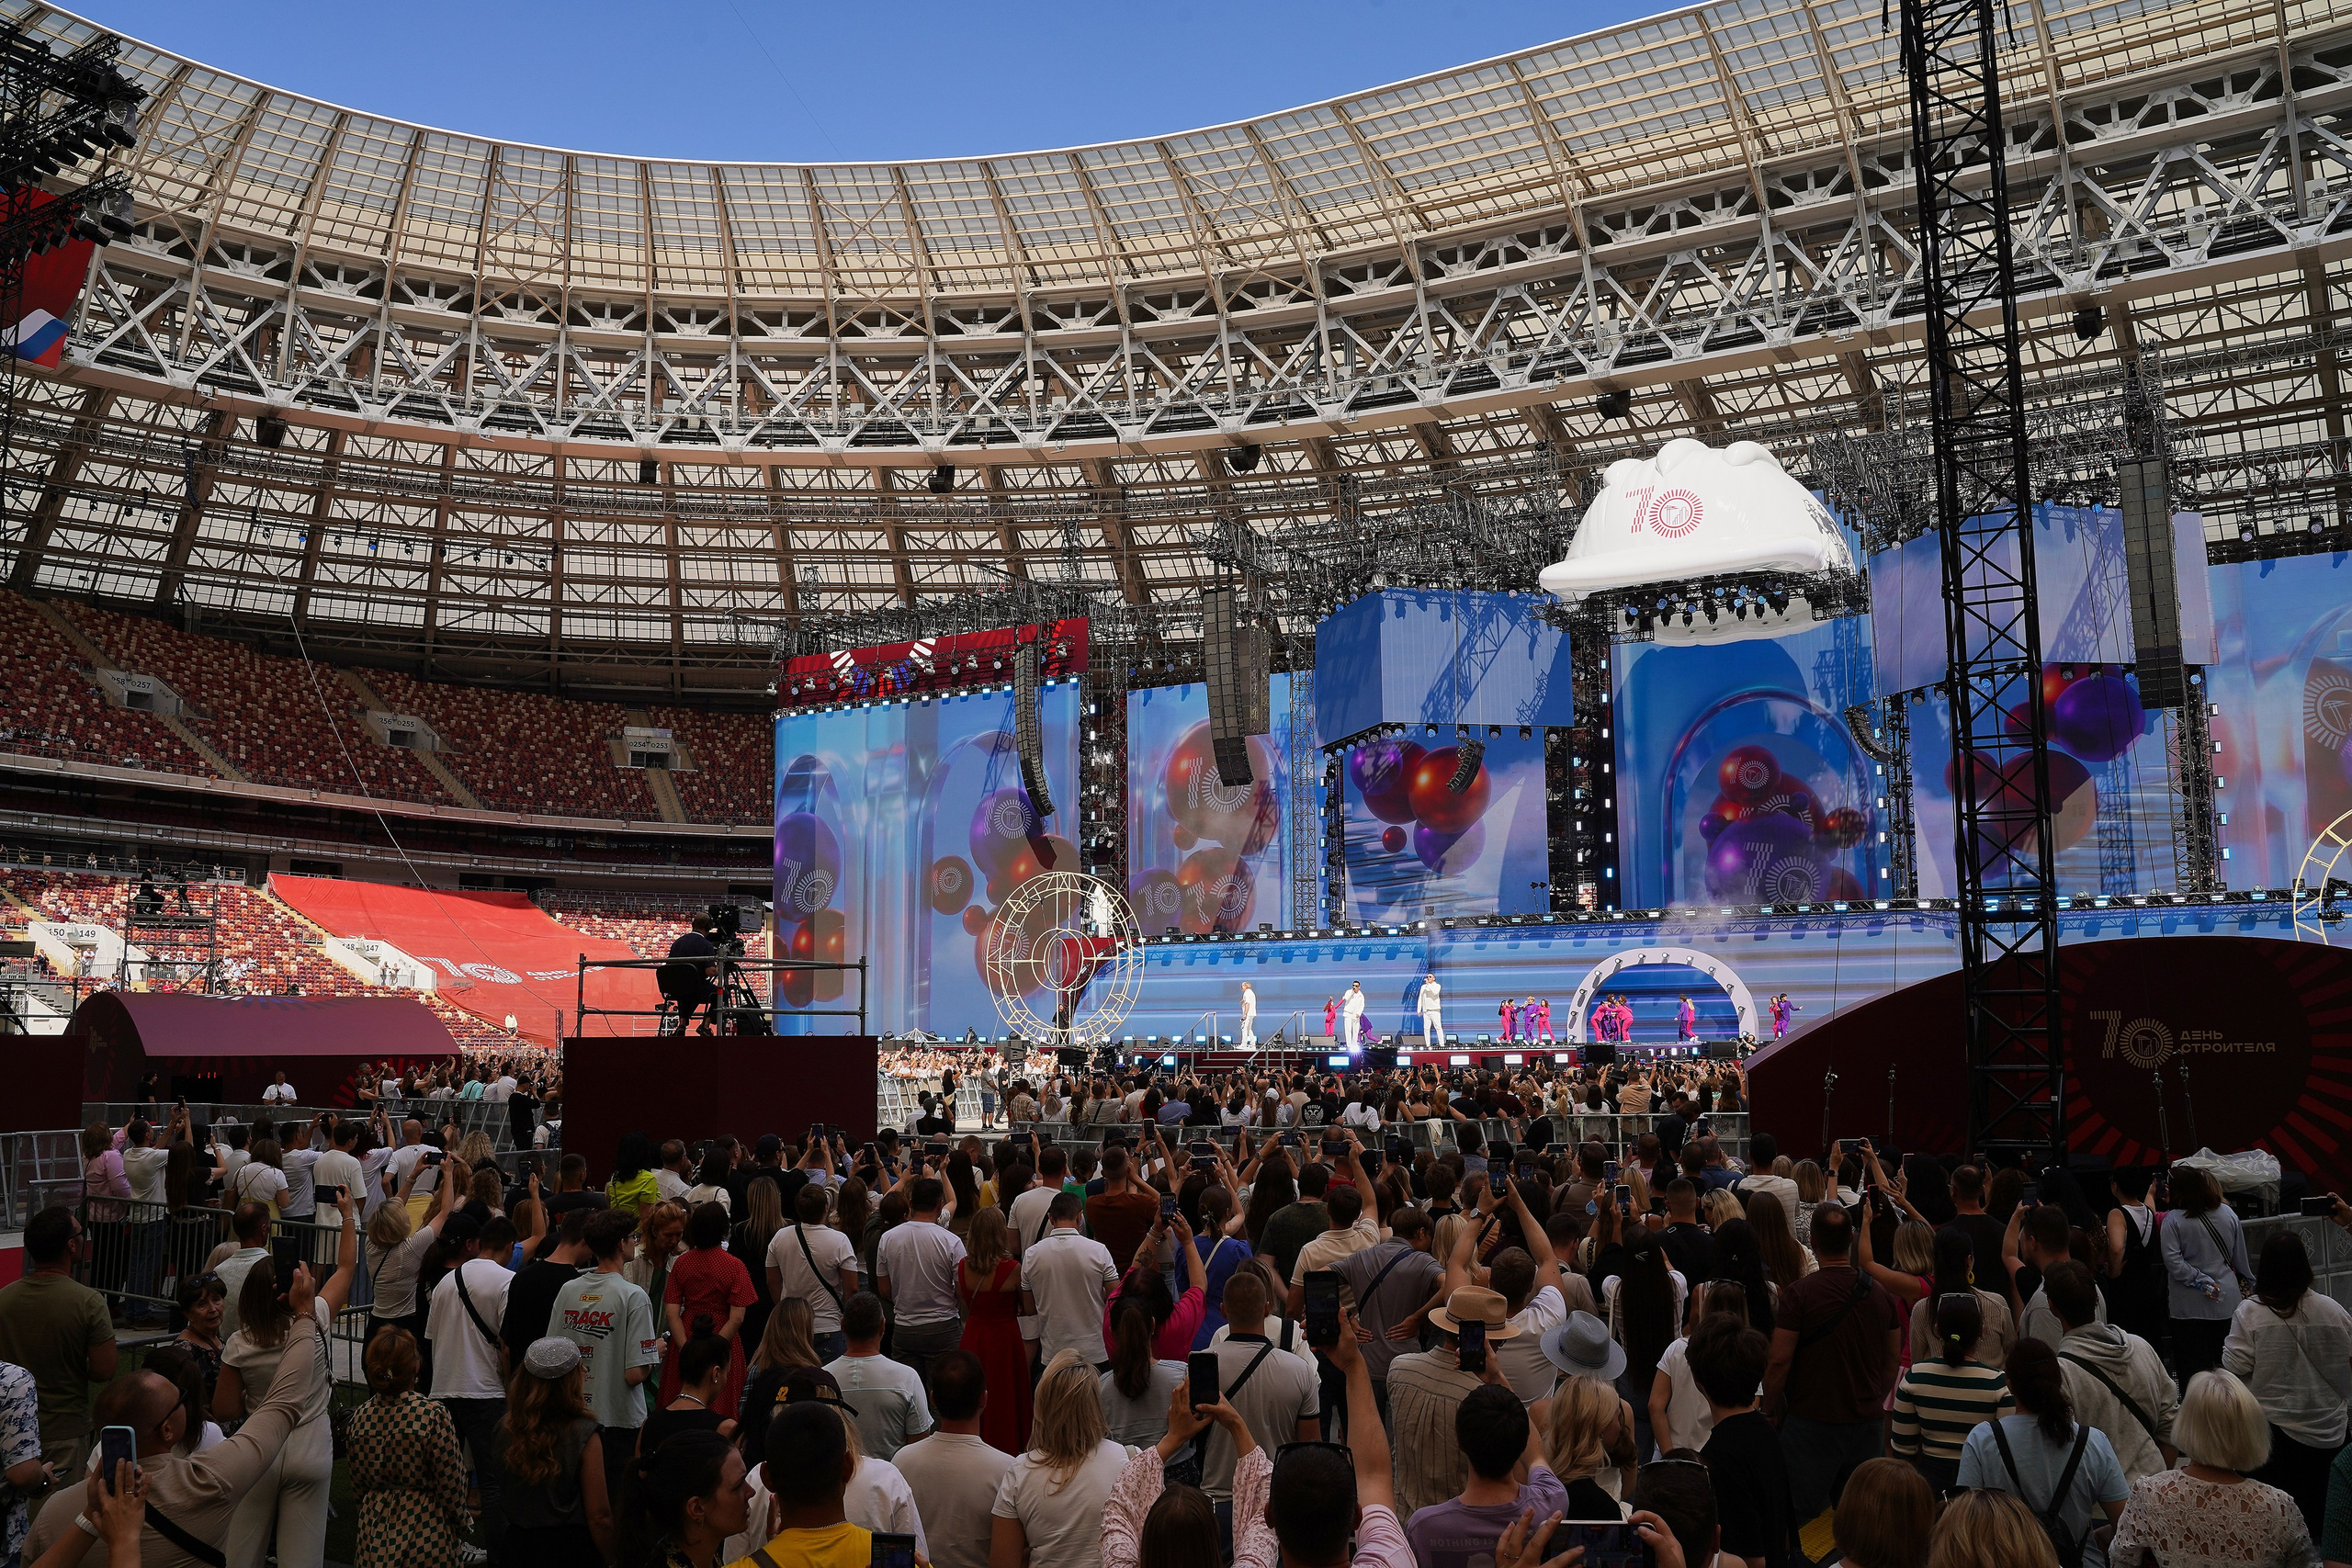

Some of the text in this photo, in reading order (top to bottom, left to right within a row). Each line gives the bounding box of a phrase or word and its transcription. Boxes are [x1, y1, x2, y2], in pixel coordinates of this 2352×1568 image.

[1625, 485, 1703, 538] 70
[137, 681, 151, 689] 257
[79, 930, 96, 938] 149
[2090, 1010, 2174, 1068] 70
[2180, 1031, 2223, 1040] ДЕНЬ
[2181, 1043, 2276, 1053] СТРОИТЕЛЯ
[564, 1310, 615, 1326] TRACK
[1430, 1539, 1479, 1547] NOTHING
